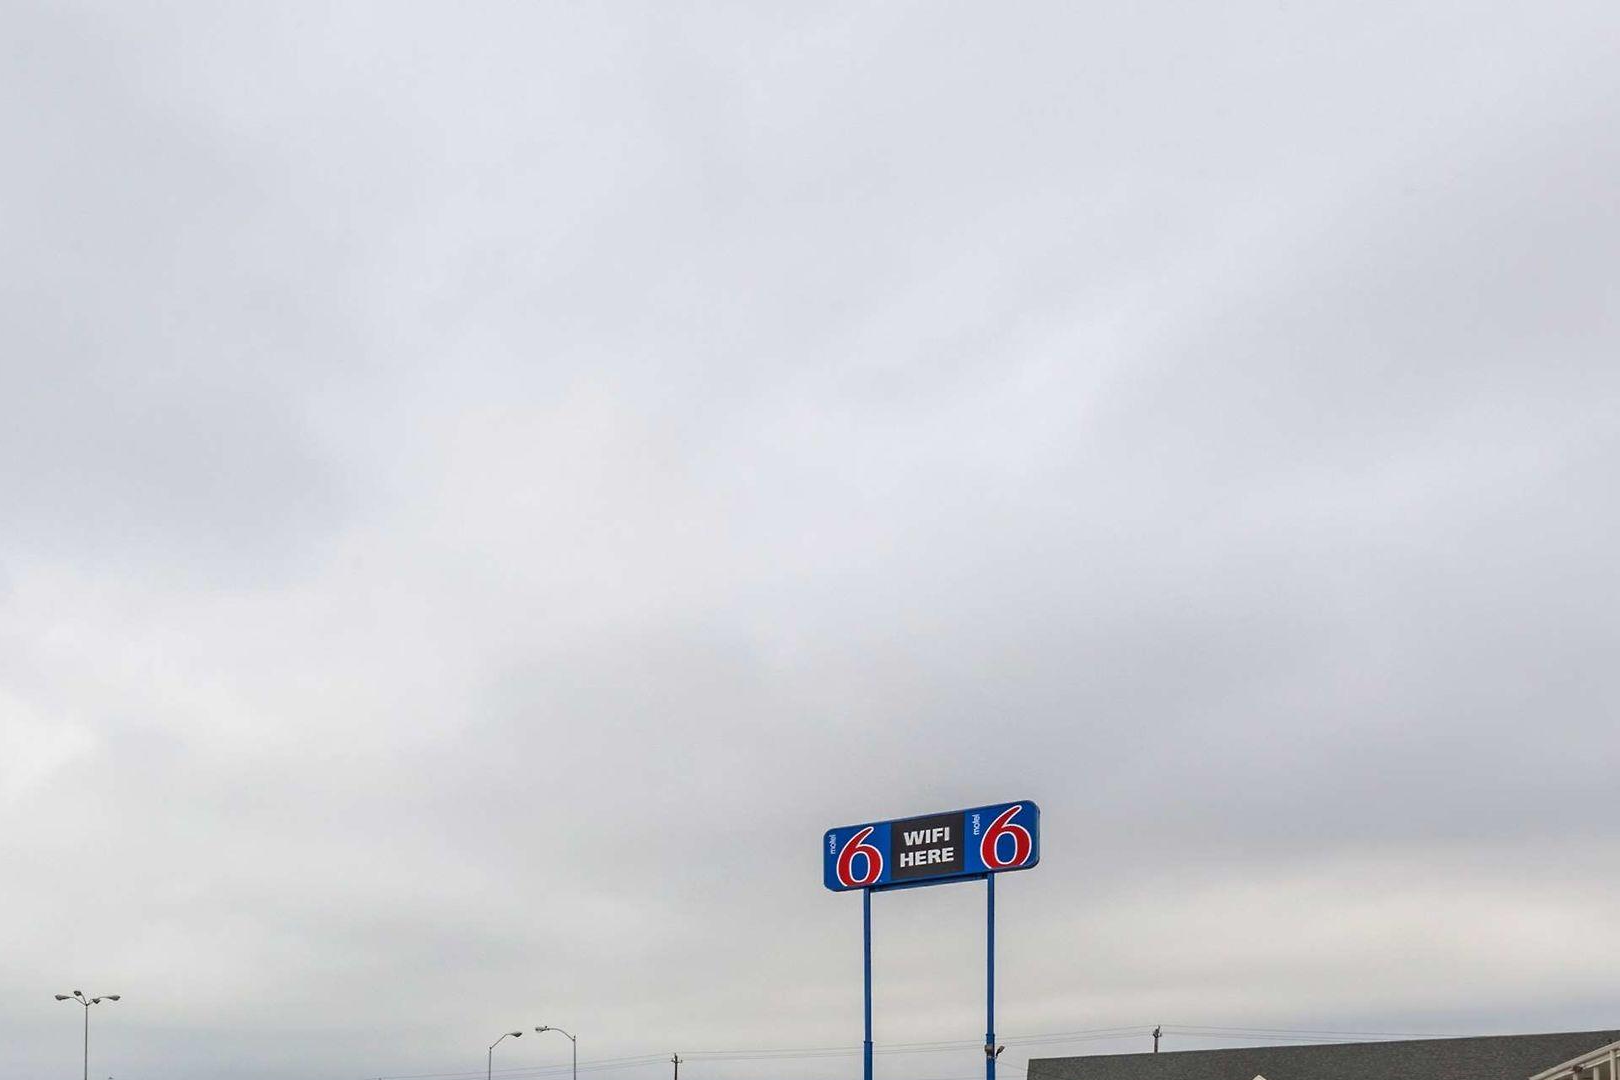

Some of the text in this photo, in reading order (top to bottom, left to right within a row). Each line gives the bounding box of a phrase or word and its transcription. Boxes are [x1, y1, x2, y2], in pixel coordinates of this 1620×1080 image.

[836, 826, 884, 888] 6
[903, 826, 951, 847] WIFI
[973, 804, 1032, 870] motel 6
[899, 847, 955, 868] HERE
